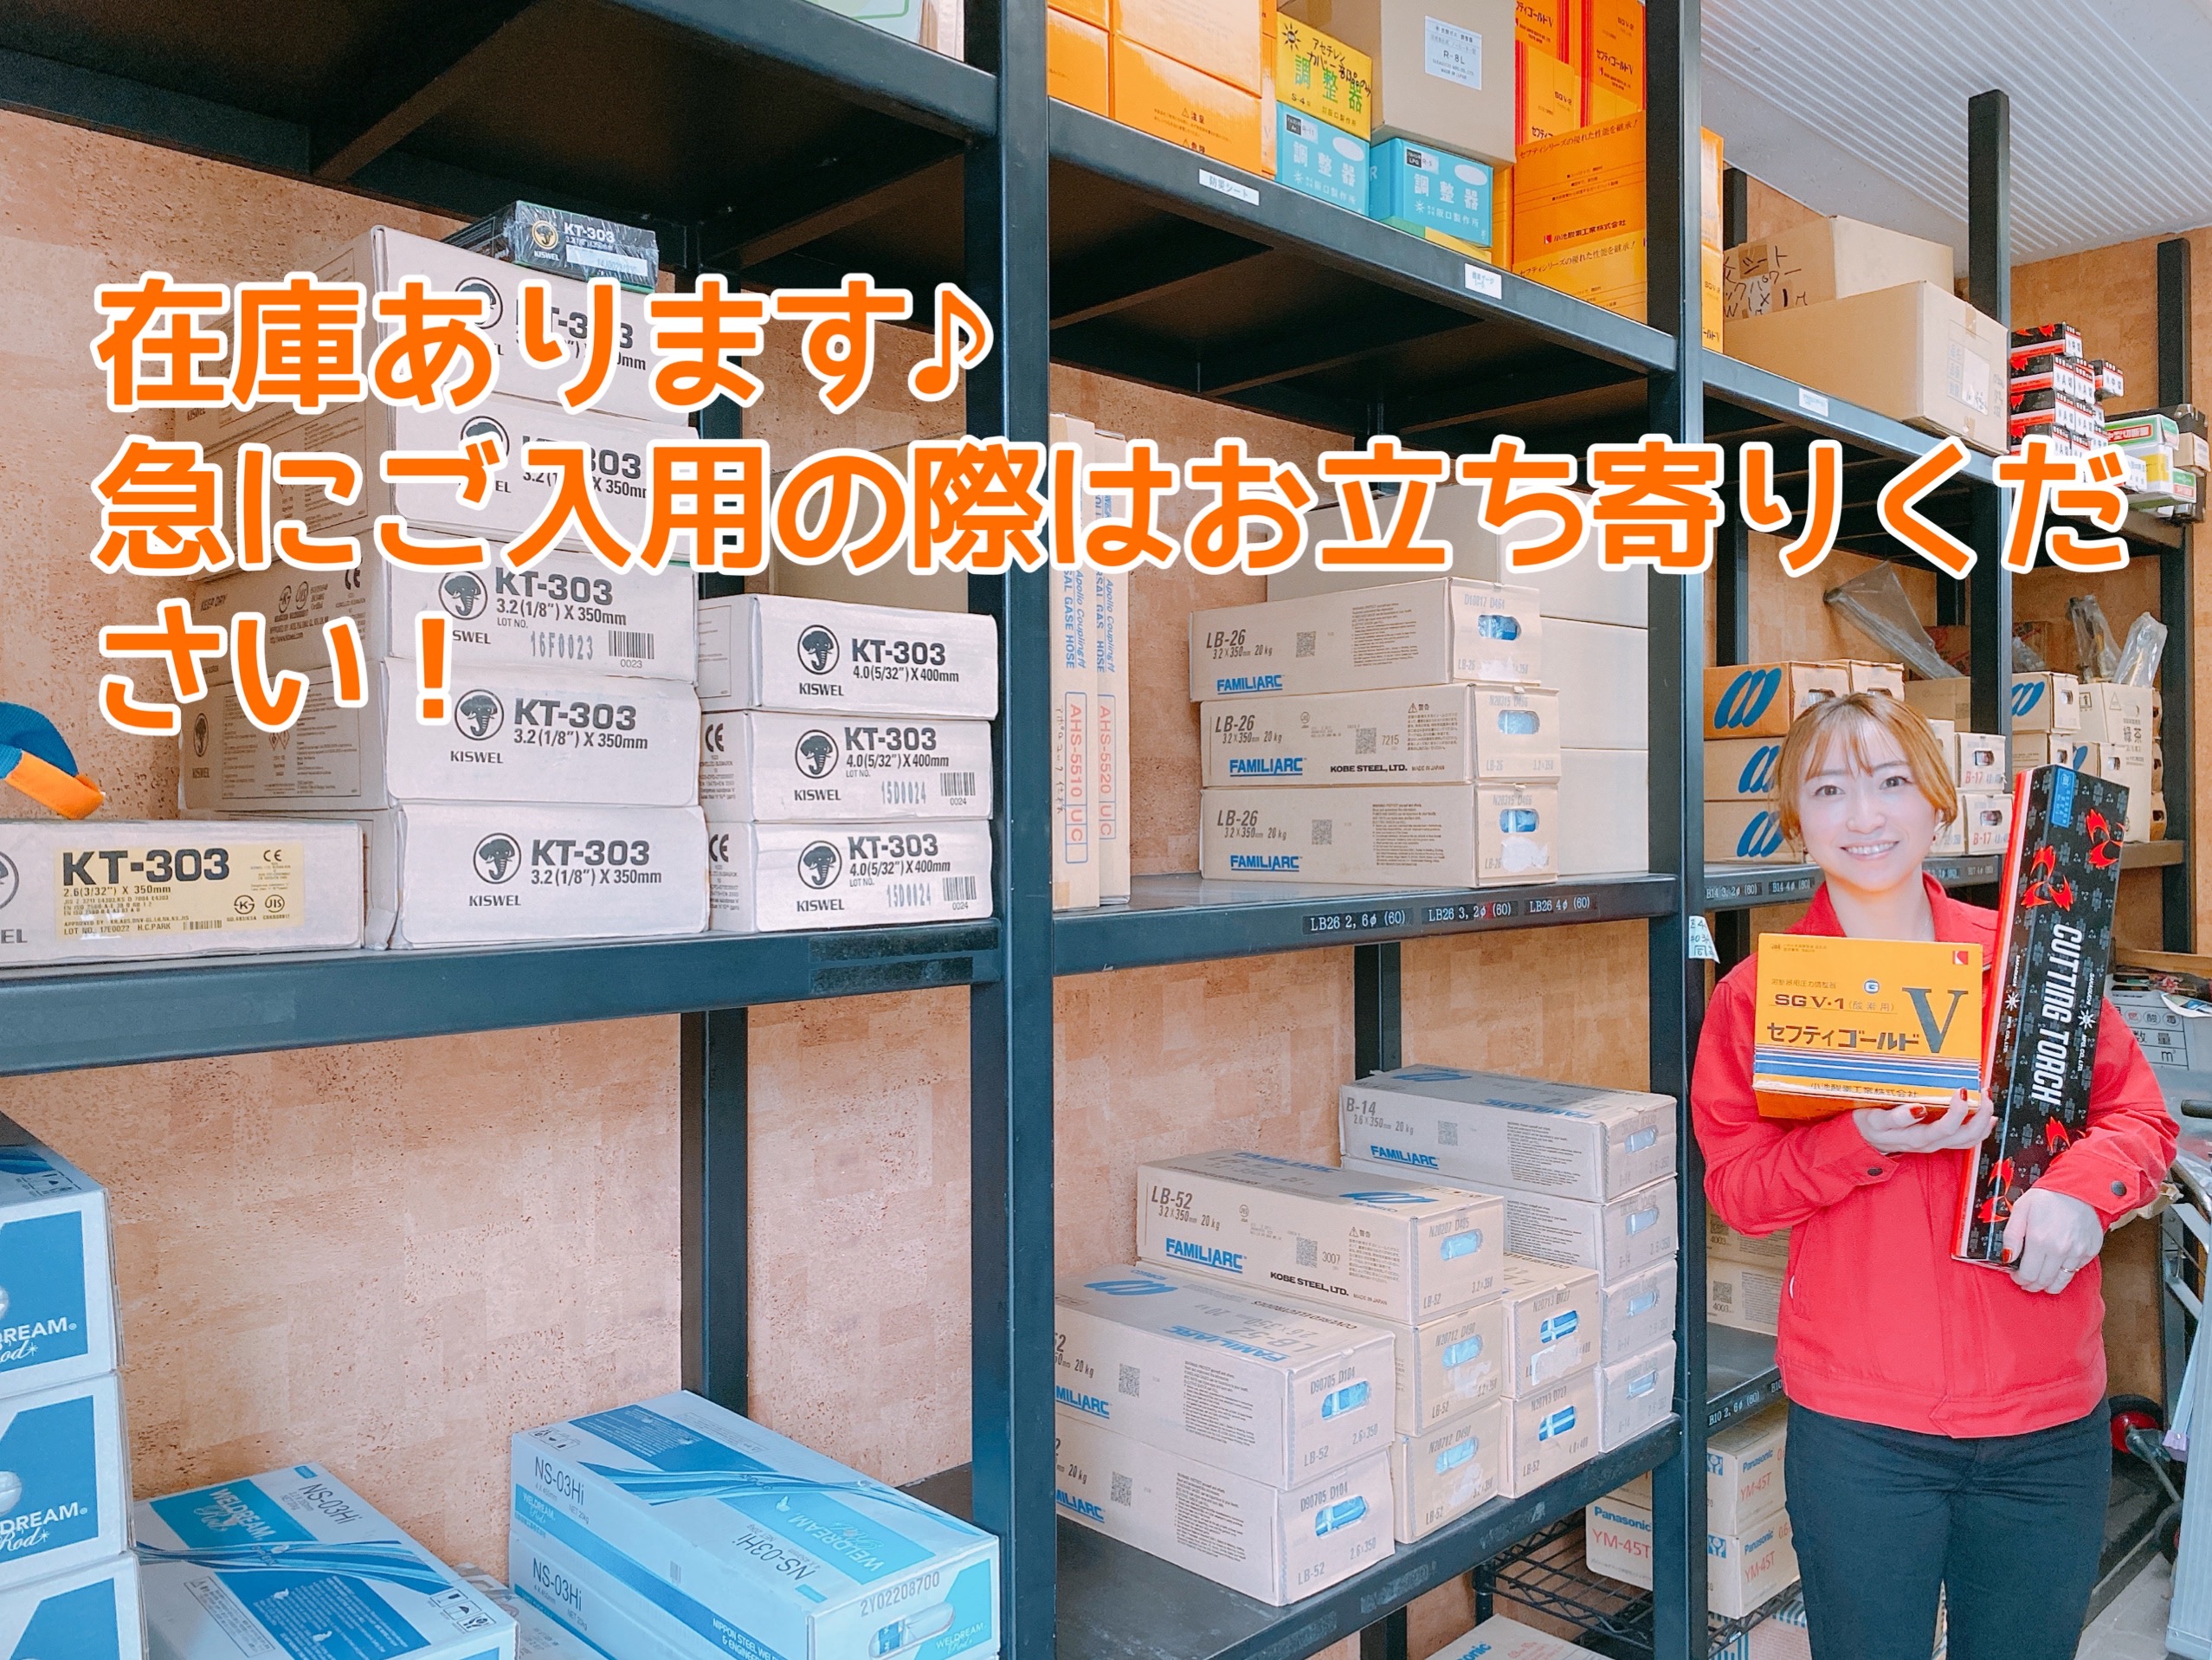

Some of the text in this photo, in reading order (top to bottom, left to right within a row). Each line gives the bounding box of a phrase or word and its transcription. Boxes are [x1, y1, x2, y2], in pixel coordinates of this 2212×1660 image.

[1294, 54, 1363, 114] 調整器
[1293, 140, 1355, 188] 調整器
[1413, 172, 1479, 211] 調整器
[564, 222, 616, 245] KT-303
[495, 566, 613, 606] KT-303
[496, 617, 513, 629] LOT
[577, 605, 627, 627] 350mm
[1065, 597, 1075, 669] GASE HOSE
[1206, 629, 1246, 649] LB-26
[850, 637, 947, 666] KT-303
[1096, 640, 1106, 673] HOSE
[619, 659, 643, 669] 0023
[919, 669, 960, 683] 400mm
[1216, 674, 1283, 694] FAMILIARC
[798, 681, 845, 697] KISWEL
[513, 696, 636, 732] KT-303
[1215, 714, 1256, 733] LB-26
[597, 733, 648, 751] 350mm
[843, 726, 938, 752] KT-303
[1099, 705, 1112, 794] AHS-5520
[1381, 734, 1400, 746] 7215
[449, 749, 505, 765] KISWEL
[912, 753, 951, 768] 400mm
[1070, 703, 1082, 798] AHS-5510
[1229, 756, 1304, 776] FAMILIARC
[1964, 771, 1983, 785] B-17
[793, 788, 842, 802] KISWEL
[949, 796, 968, 807] 0024
[1216, 809, 1259, 827] LB-26
[847, 833, 940, 861] KT-303
[1972, 831, 1992, 846] B-17
[530, 837, 650, 867] KT-303
[1229, 854, 1299, 871] FAMILIARC
[62, 847, 230, 887] KT-303
[914, 858, 951, 873] 400mm
[613, 869, 663, 885] 350mm
[133, 884, 171, 895] 350mm
[468, 894, 522, 908] KISWEL
[796, 898, 846, 913] KISWEL
[951, 900, 970, 911] 0024
[1428, 901, 1512, 922] LB26 (60)
[1528, 895, 1590, 914] LB26 (60)
[1309, 908, 1407, 932] LB26 (60)
[1774, 993, 1808, 1008] SG
[1901, 986, 1970, 1054] V
[2030, 922, 2084, 1107] CUTTING TORCH
[1766, 1022, 1920, 1052] セフティゴールド
[1346, 1096, 1377, 1116] B-14
[1151, 1185, 1193, 1211] LB-52
[1710, 1235, 1727, 1246] 4003
[1165, 1237, 1244, 1273] FAMILIARC
[1322, 1250, 1341, 1265] 3007
[1270, 1271, 1297, 1285] KOBE
[1423, 1292, 1441, 1309] LB-52
[1712, 1302, 1730, 1314] 4003
[1074, 1358, 1084, 1373] 20
[1431, 1400, 1450, 1418] LB-52
[1709, 1413, 1723, 1427] B10
[1304, 1445, 1330, 1468] LB-52
[1742, 1448, 1774, 1474] Panasonic
[1067, 1463, 1078, 1478] 20
[1523, 1459, 1540, 1477] LB-52
[534, 1456, 585, 1507] NS-03Hi
[1740, 1472, 1772, 1502] YM-45T
[209, 1488, 277, 1538] WELDREAM
[299, 1482, 363, 1525] NS-03Hi
[521, 1491, 555, 1521] WELDREAM
[1425, 1505, 1444, 1526] LB-52
[1593, 1505, 1652, 1533] Panasonic
[789, 1515, 885, 1573] WELDREAM
[1591, 1528, 1650, 1559] YM-45T
[1744, 1527, 1775, 1556] Panasonic
[732, 1533, 816, 1581] NS-03Hi
[1744, 1550, 1776, 1583] YM-45T
[532, 1557, 583, 1612] NS-03Hi
[1298, 1561, 1325, 1586] LB-52
[860, 1570, 941, 1618] 2Y02208700
[713, 1617, 737, 1641] NIPPON
[737, 1633, 758, 1654] STEEL
[936, 1624, 984, 1650] WELDREAM
